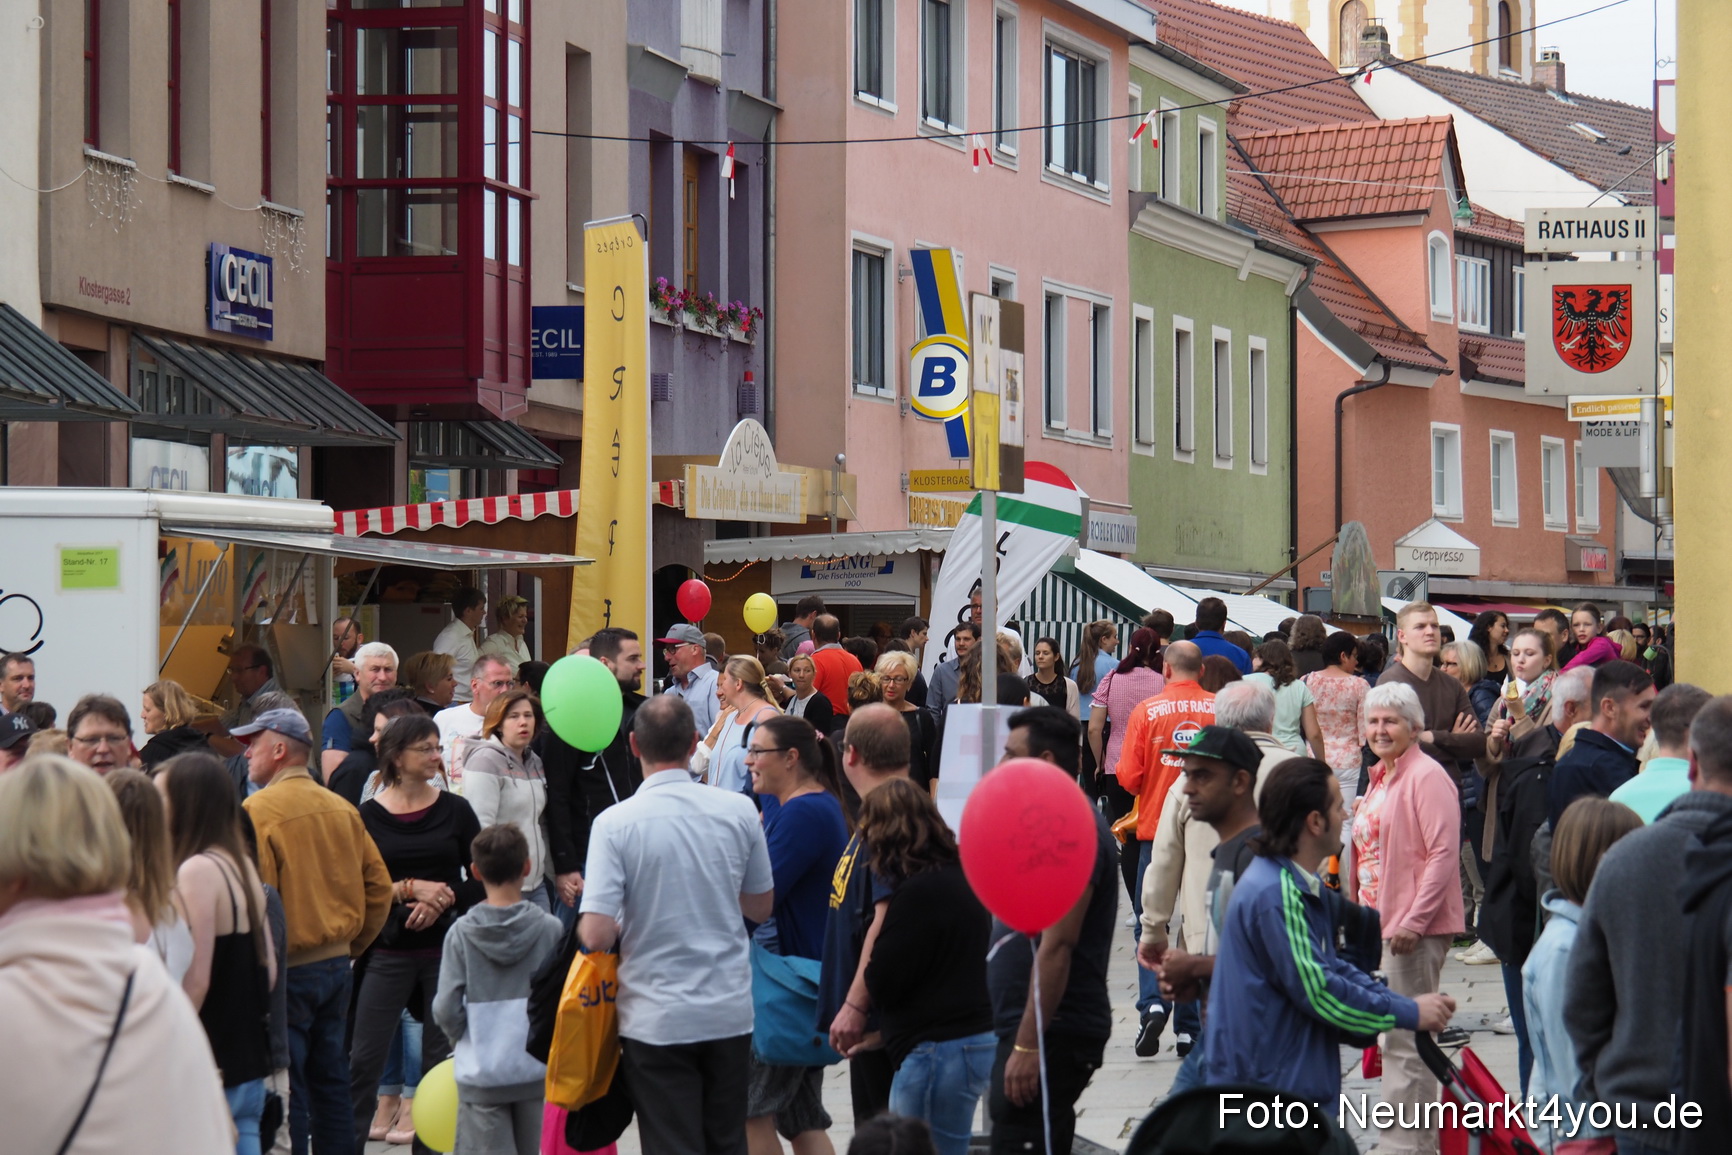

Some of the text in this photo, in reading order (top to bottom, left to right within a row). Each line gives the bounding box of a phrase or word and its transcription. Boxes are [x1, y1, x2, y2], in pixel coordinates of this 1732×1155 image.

[1538, 219, 1646, 239] RATHAUS II
[79, 276, 131, 306] Klostergasse 2
[221, 253, 273, 310] CECIL
[980, 313, 993, 346] WC
[918, 356, 957, 397] B
[1576, 403, 1606, 414] Endlich
[1585, 428, 1612, 437] MODE
[1616, 428, 1621, 437] &
[1087, 520, 1137, 545] ROELEKTRONIK
[63, 557, 109, 566] Stand-Nr. 17
[826, 556, 870, 571] LANG
[1412, 547, 1465, 567] Creppresso
[817, 572, 830, 581] Die
[844, 579, 862, 588] 1900
[1147, 701, 1176, 721] SPIRIT
[1177, 700, 1189, 713] OF
[1174, 732, 1196, 742] Gu
